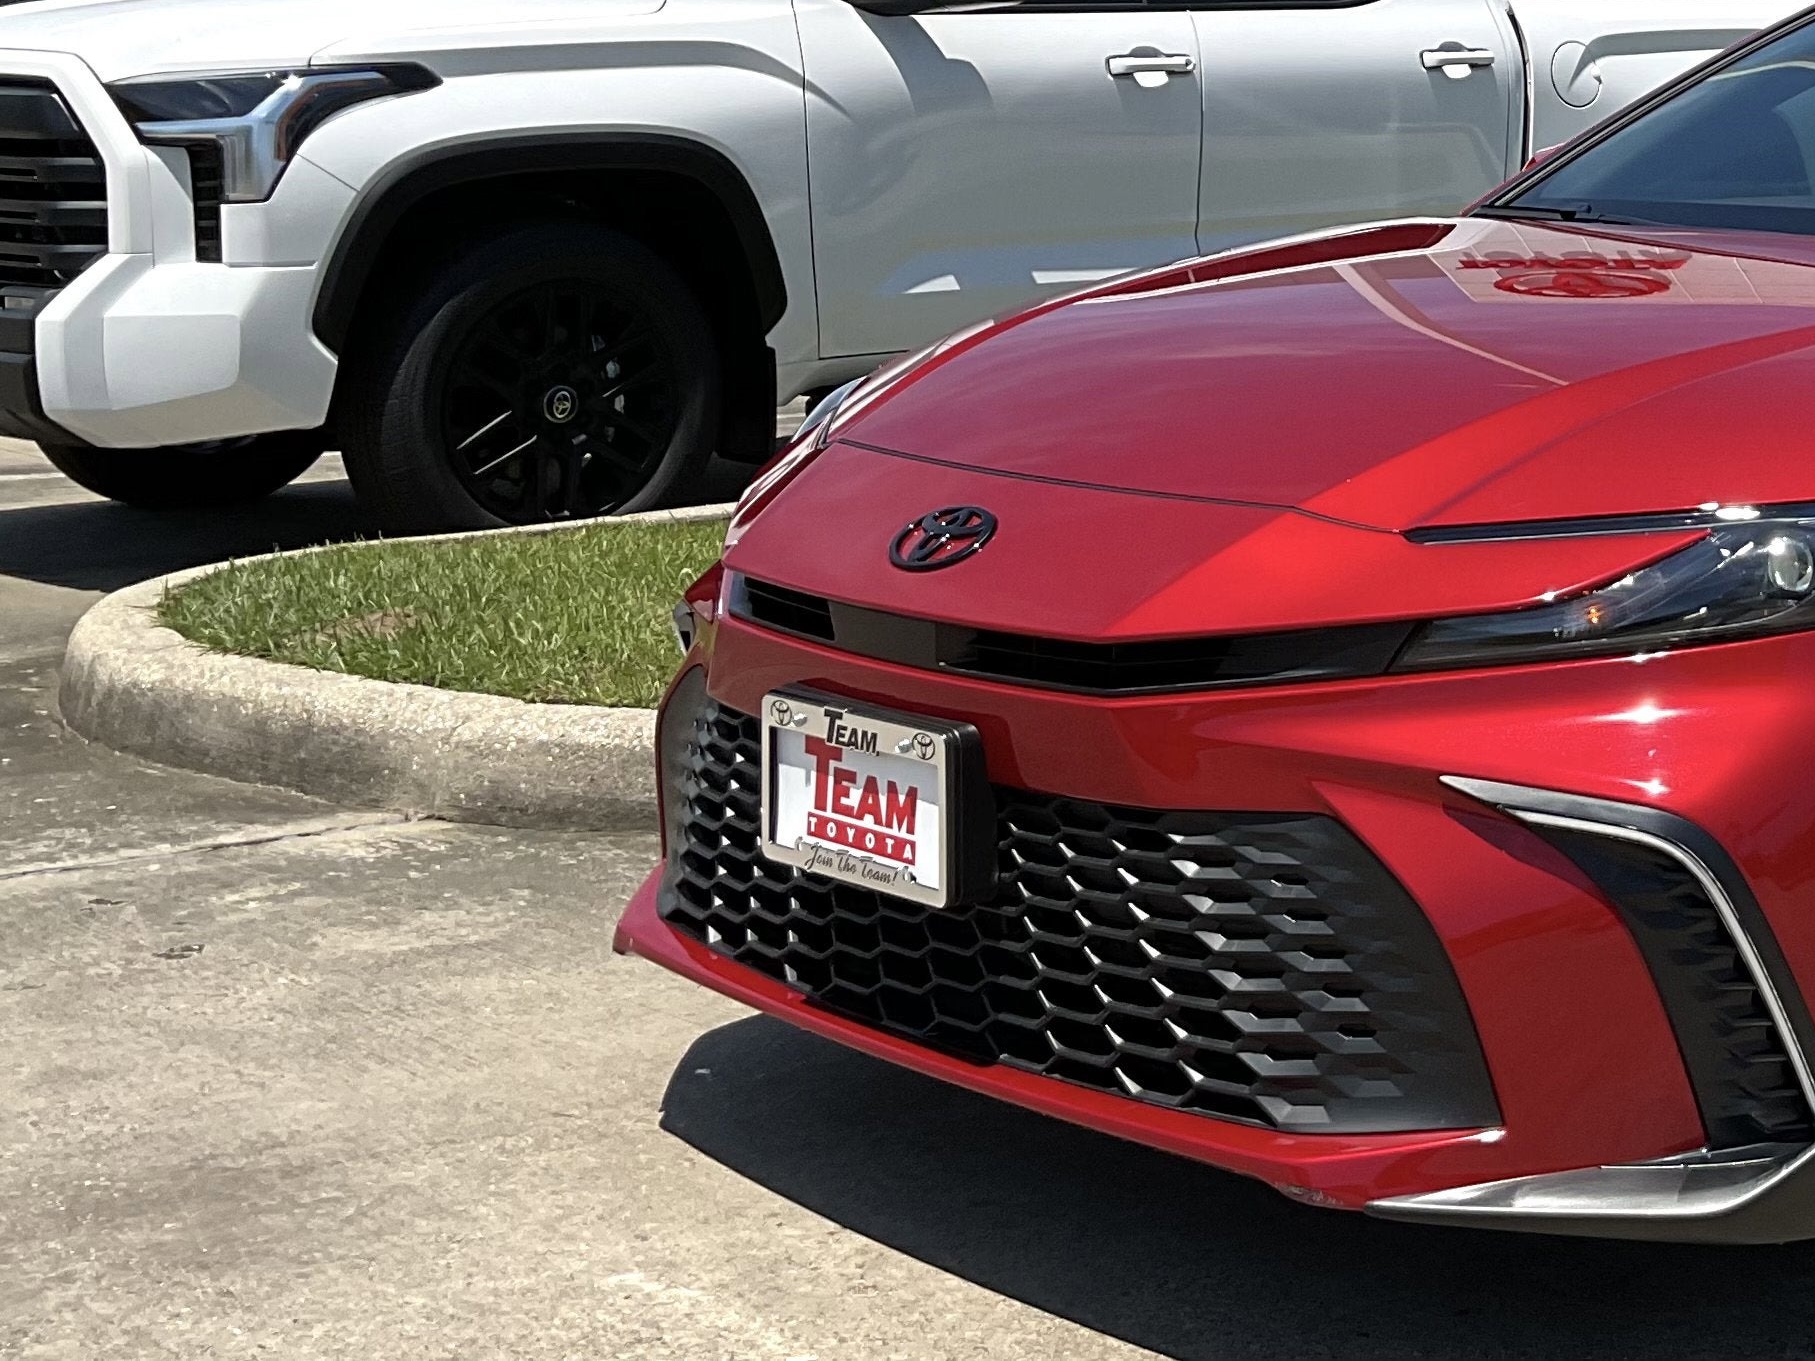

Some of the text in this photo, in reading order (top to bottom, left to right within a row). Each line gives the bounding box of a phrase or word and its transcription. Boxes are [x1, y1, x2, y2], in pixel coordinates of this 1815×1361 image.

[805, 734, 918, 835] TEAM
[809, 816, 913, 860] TOYOTA
[804, 841, 899, 886] Join The Team!
